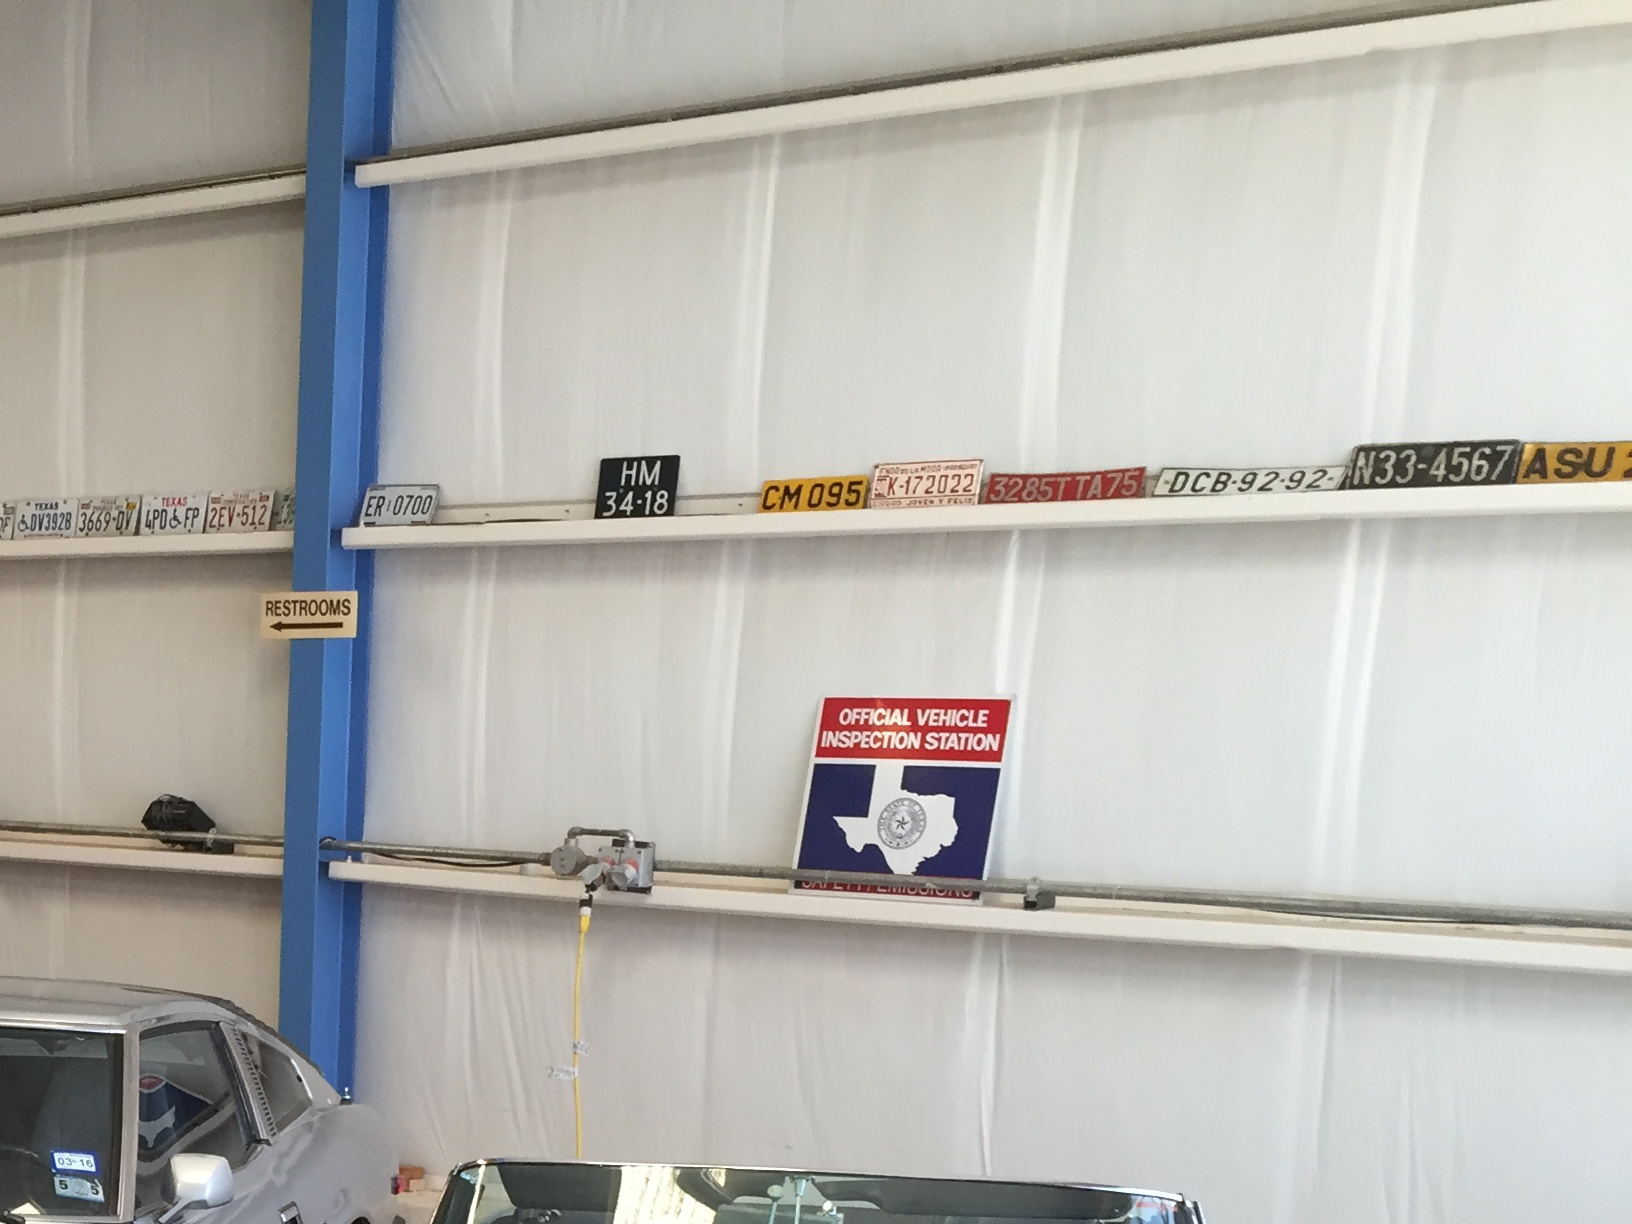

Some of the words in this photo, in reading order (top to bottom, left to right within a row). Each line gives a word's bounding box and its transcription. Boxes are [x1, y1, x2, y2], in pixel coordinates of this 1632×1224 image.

[620, 459, 662, 487] HM
[1352, 445, 1515, 486] N33-4567
[1522, 446, 1616, 479] ASU
[762, 483, 804, 511] CM
[807, 480, 864, 509] 095
[886, 473, 975, 497] K-172022
[34, 501, 59, 511] TEXAS
[161, 496, 188, 508] TEXAS
[364, 495, 386, 518] ER
[392, 494, 433, 516] 0700
[602, 489, 669, 517] 34-18
[265, 598, 352, 617] RESTROOMS
[838, 707, 912, 727] OFFICIAL
[917, 708, 990, 728] VEHICLE
[820, 730, 921, 750] INSPECTION
[924, 732, 1001, 751] STATION
[59, 1180, 69, 1190] 5
